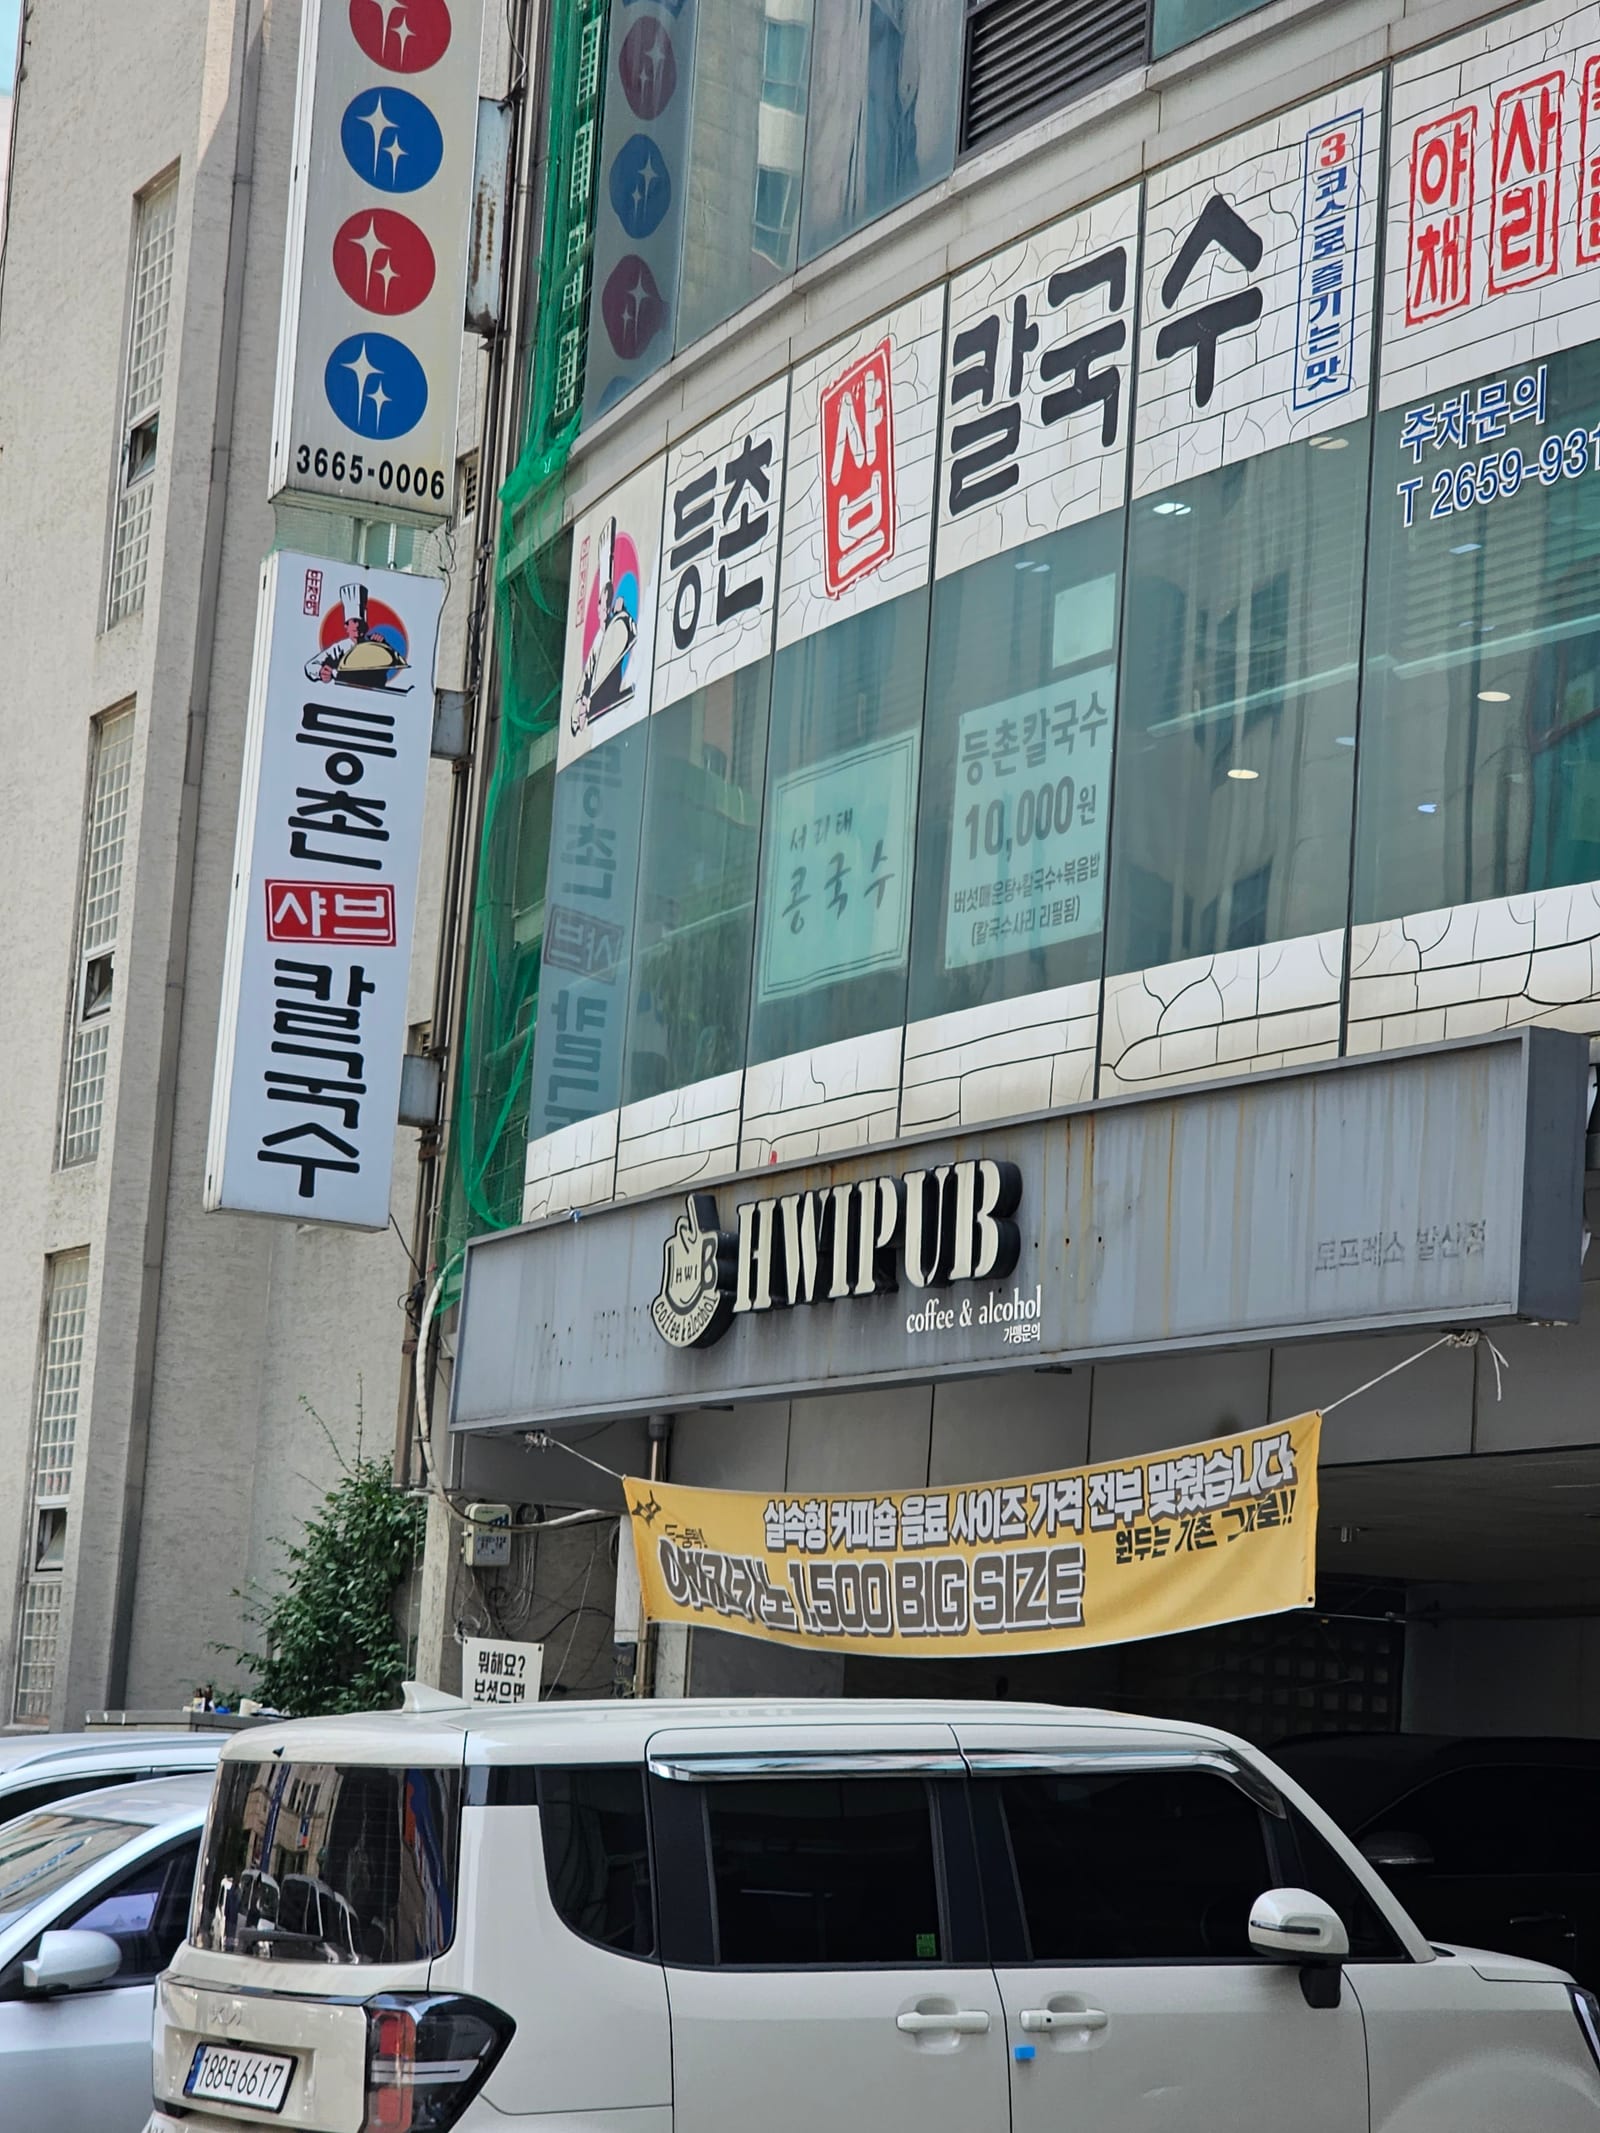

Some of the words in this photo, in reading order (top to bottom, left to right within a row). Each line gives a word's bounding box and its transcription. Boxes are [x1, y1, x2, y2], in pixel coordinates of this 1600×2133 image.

[1413, 122, 1469, 309] 야채
[1500, 86, 1557, 272] 사리
[669, 433, 773, 650] 등촌
[831, 370, 886, 588] 샤브
[949, 195, 1264, 517] 칼국수
[1400, 364, 1548, 464] 주차문의
[297, 444, 445, 500] 3665-0006
[1397, 476, 1423, 527] T
[962, 690, 1108, 786] 등촌칼국수
[288, 701, 397, 870] 등촌
[273, 888, 390, 938] 샤브
[782, 839, 896, 934] 콩국수
[257, 957, 376, 1198] 칼국수
[675, 1264, 698, 1284] HWI
[906, 1298, 954, 1334] coffee
[959, 1298, 973, 1328] &
[978, 1284, 1042, 1324] alcohol
[1003, 1322, 1041, 1345] 가맹문의
[764, 1500, 828, 1553] 실속형
[830, 1498, 898, 1551] 커피숍
[900, 1494, 950, 1548] 음료
[951, 1486, 1027, 1543] 사이즈
[1030, 1476, 1086, 1535] 가격
[1088, 1466, 1144, 1529] 전부
[1147, 1431, 1298, 1523] 맞췄습니다
[1115, 1525, 1172, 1565] 원두는
[1174, 1514, 1218, 1553] 기존
[894, 1556, 970, 1637] BIG
[973, 1542, 1085, 1635] SIZE
[478, 1651, 526, 1678] 뭐해요?
[199, 2053, 284, 2099] 188더6617
